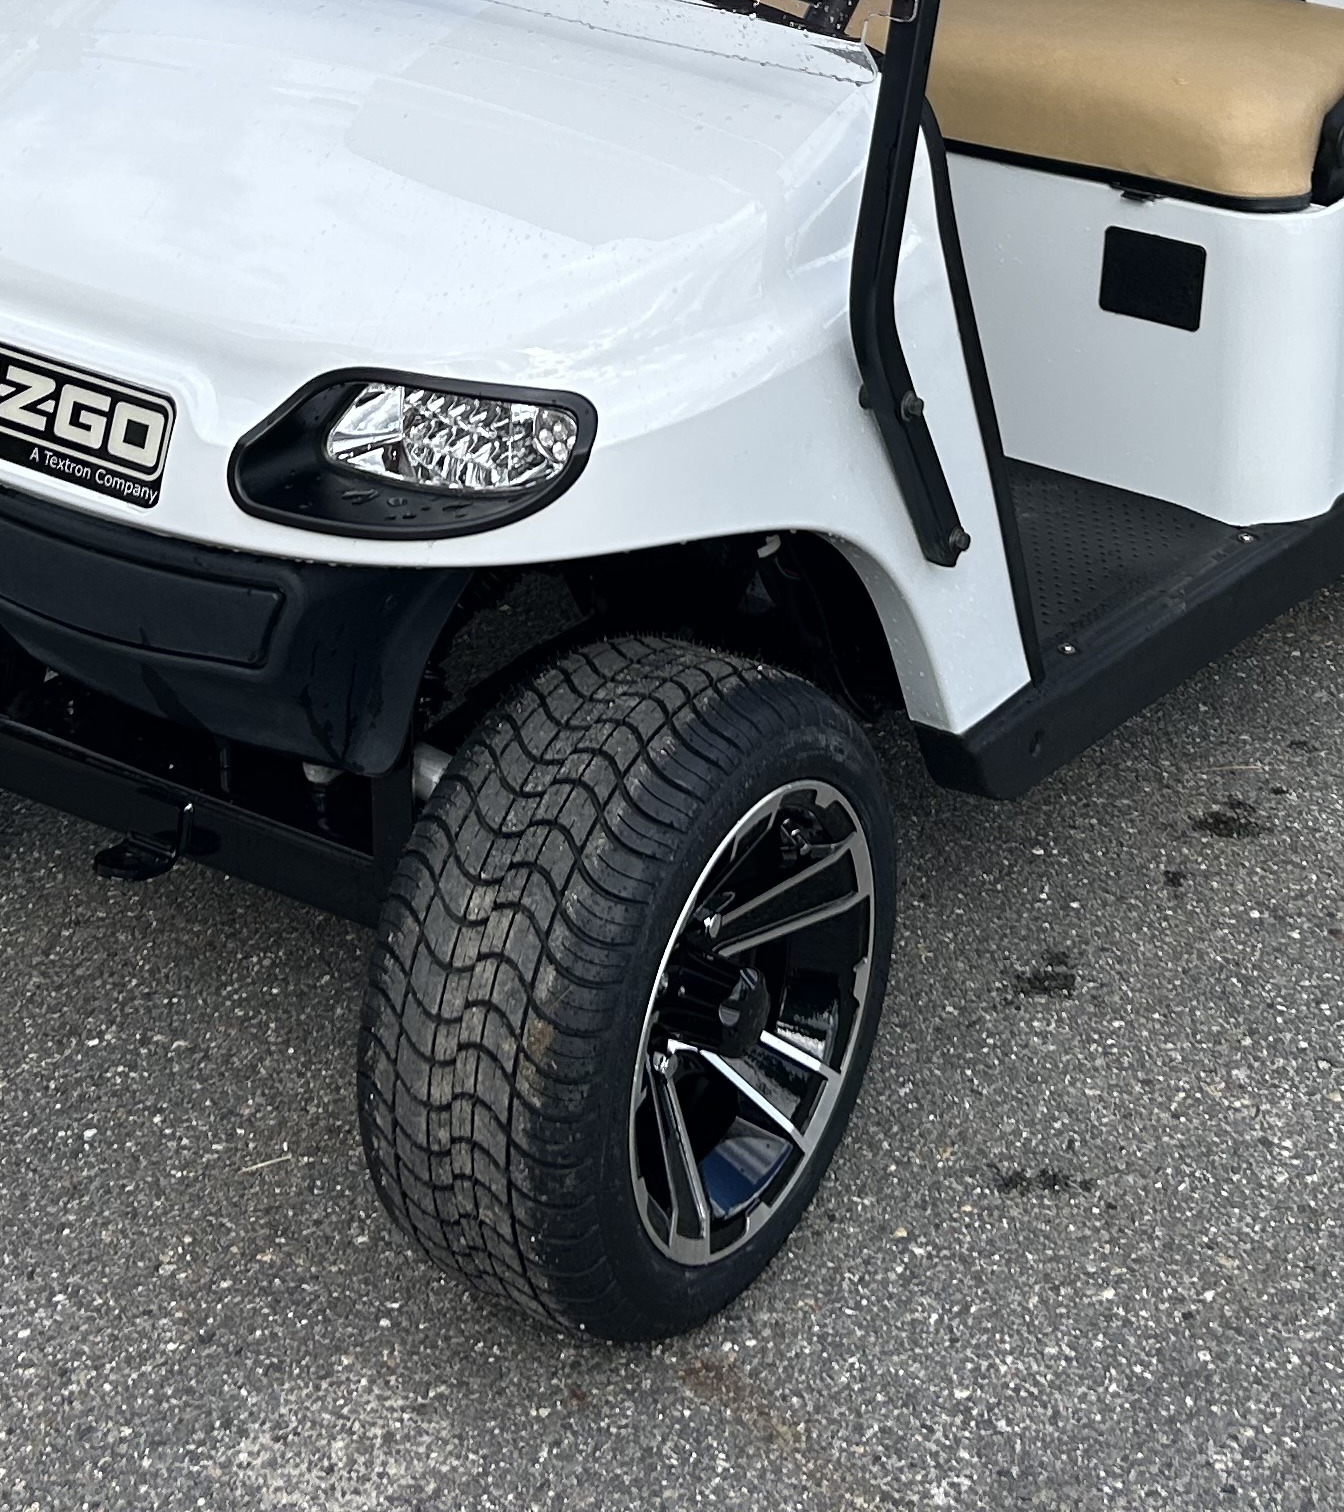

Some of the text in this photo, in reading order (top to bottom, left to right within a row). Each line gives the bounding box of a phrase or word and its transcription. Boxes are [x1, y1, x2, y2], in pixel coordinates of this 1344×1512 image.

[29, 446, 158, 504] A Textron Company
